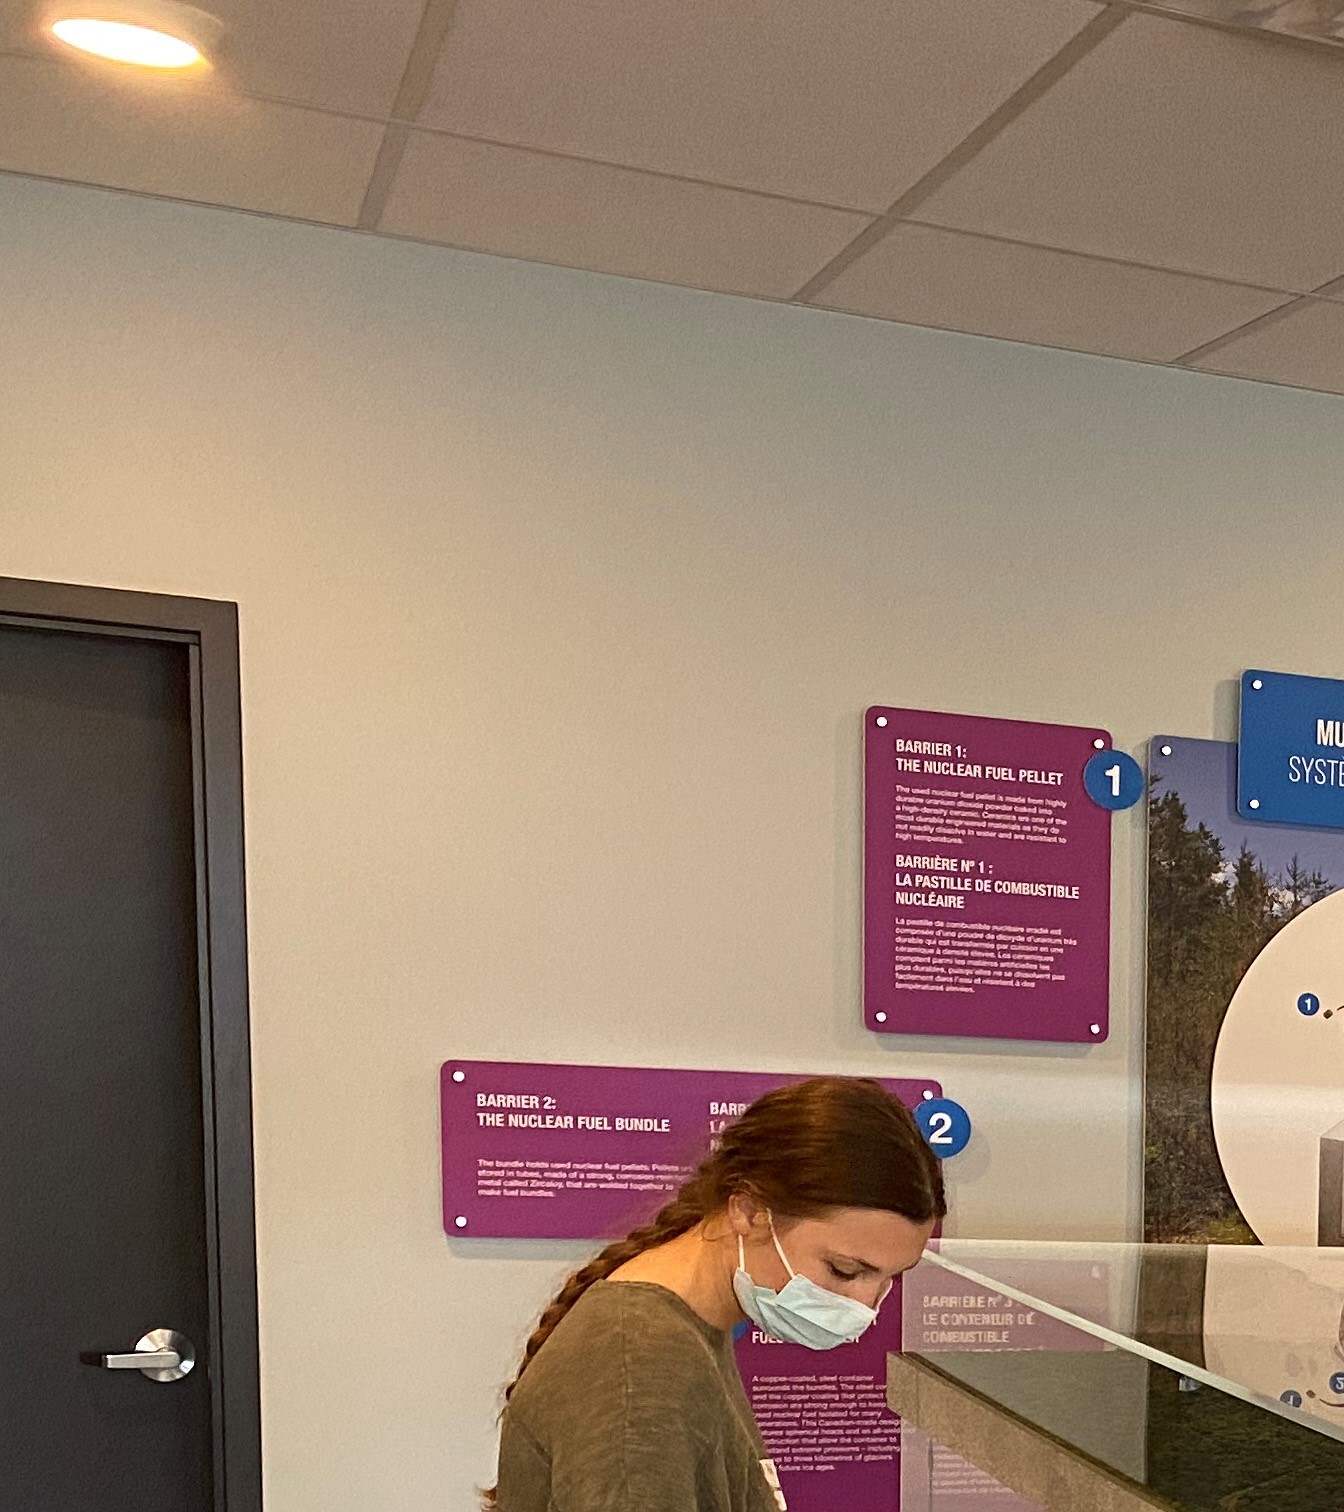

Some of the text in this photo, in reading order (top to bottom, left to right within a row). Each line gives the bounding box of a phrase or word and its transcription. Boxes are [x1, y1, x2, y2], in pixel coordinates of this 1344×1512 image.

[896, 739, 966, 758] BARRIER 1:
[896, 758, 1063, 785] THE NUCLEAR FUEL PELLET
[1105, 765, 1120, 796] 1
[896, 855, 958, 871] BARRIÈRE
[979, 861, 984, 873] 1
[896, 873, 1079, 899] LA PASTILLE DE COMBUSTIBLE
[896, 892, 964, 908] NUCLÉAIRE
[1305, 998, 1311, 1010] 1
[477, 1093, 556, 1109] BARRIER 2:
[477, 1113, 670, 1132] THE NUCLEAR FUEL BUNDLE
[929, 1113, 953, 1144] 2
